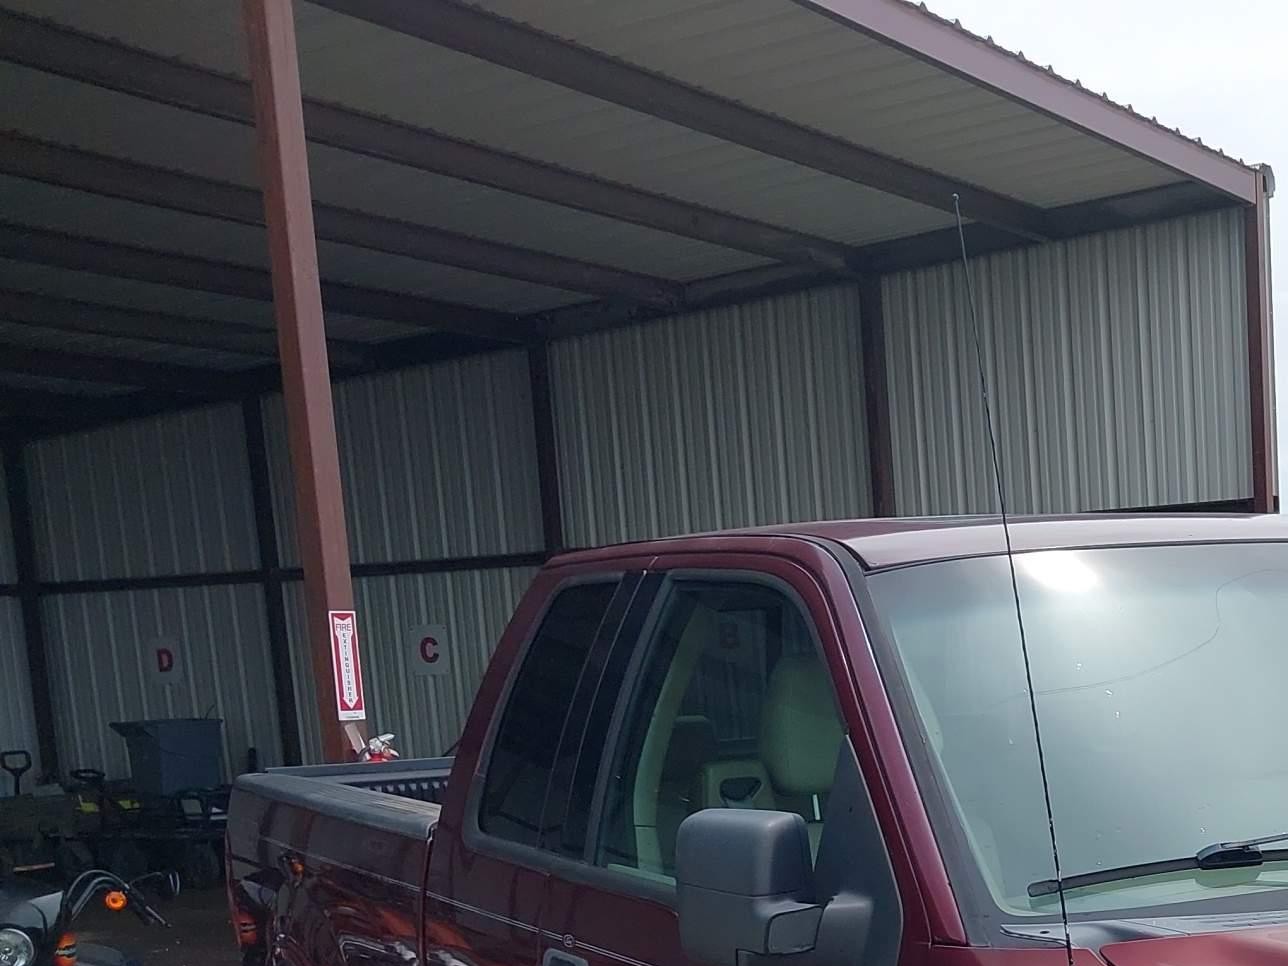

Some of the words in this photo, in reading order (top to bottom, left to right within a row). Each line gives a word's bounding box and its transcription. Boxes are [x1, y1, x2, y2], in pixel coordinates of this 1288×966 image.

[335, 623, 352, 632] FIRE
[156, 648, 173, 672] D
[420, 636, 440, 664] C
[342, 632, 354, 703] EXTINGUISHER
